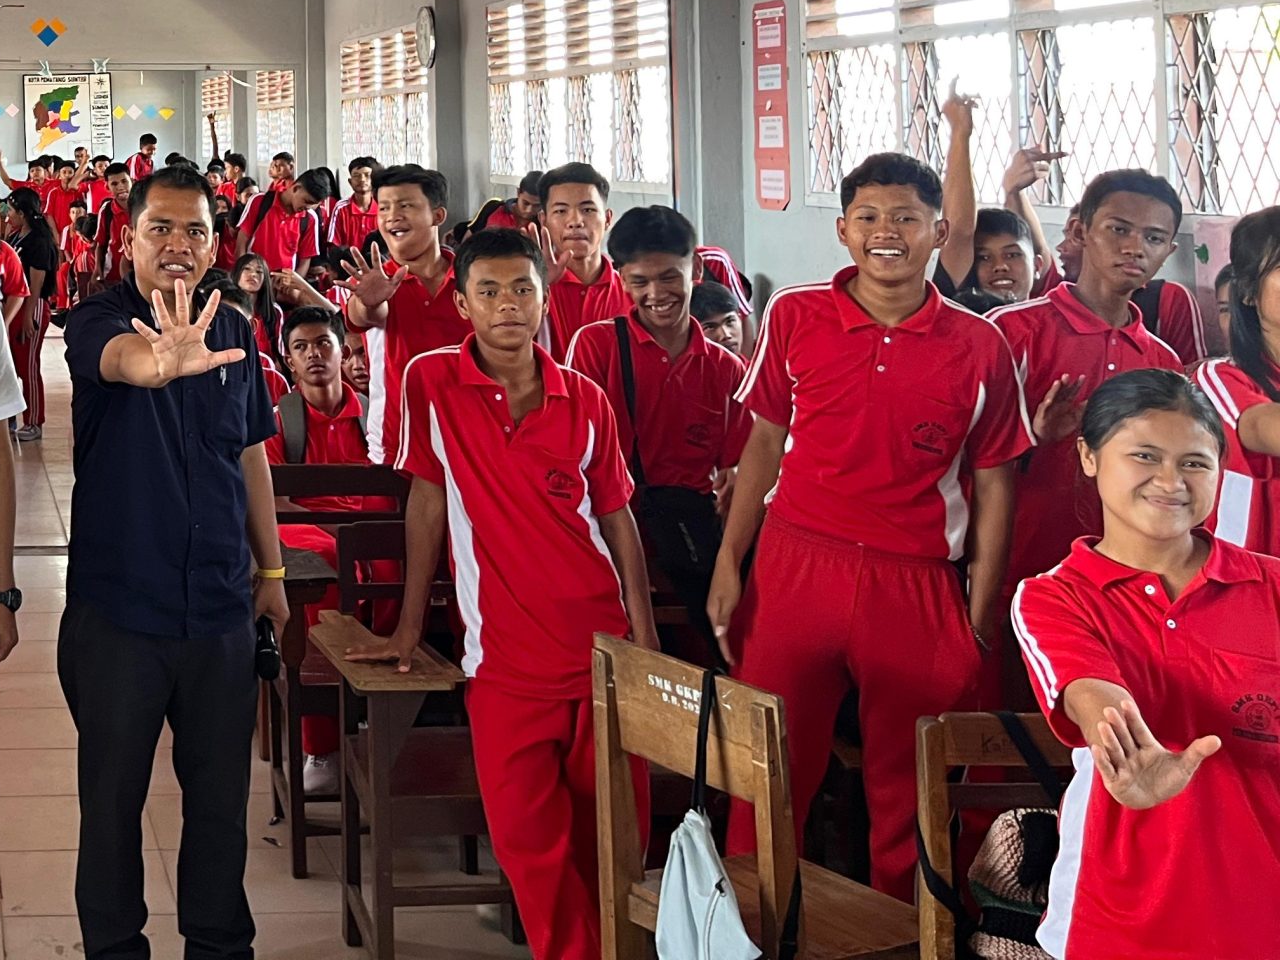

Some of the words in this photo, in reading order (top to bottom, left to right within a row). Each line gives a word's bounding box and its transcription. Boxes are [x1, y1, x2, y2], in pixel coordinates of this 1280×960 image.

[647, 673, 672, 692] SMK
[675, 683, 702, 702] GKP
[681, 699, 700, 714] 202
